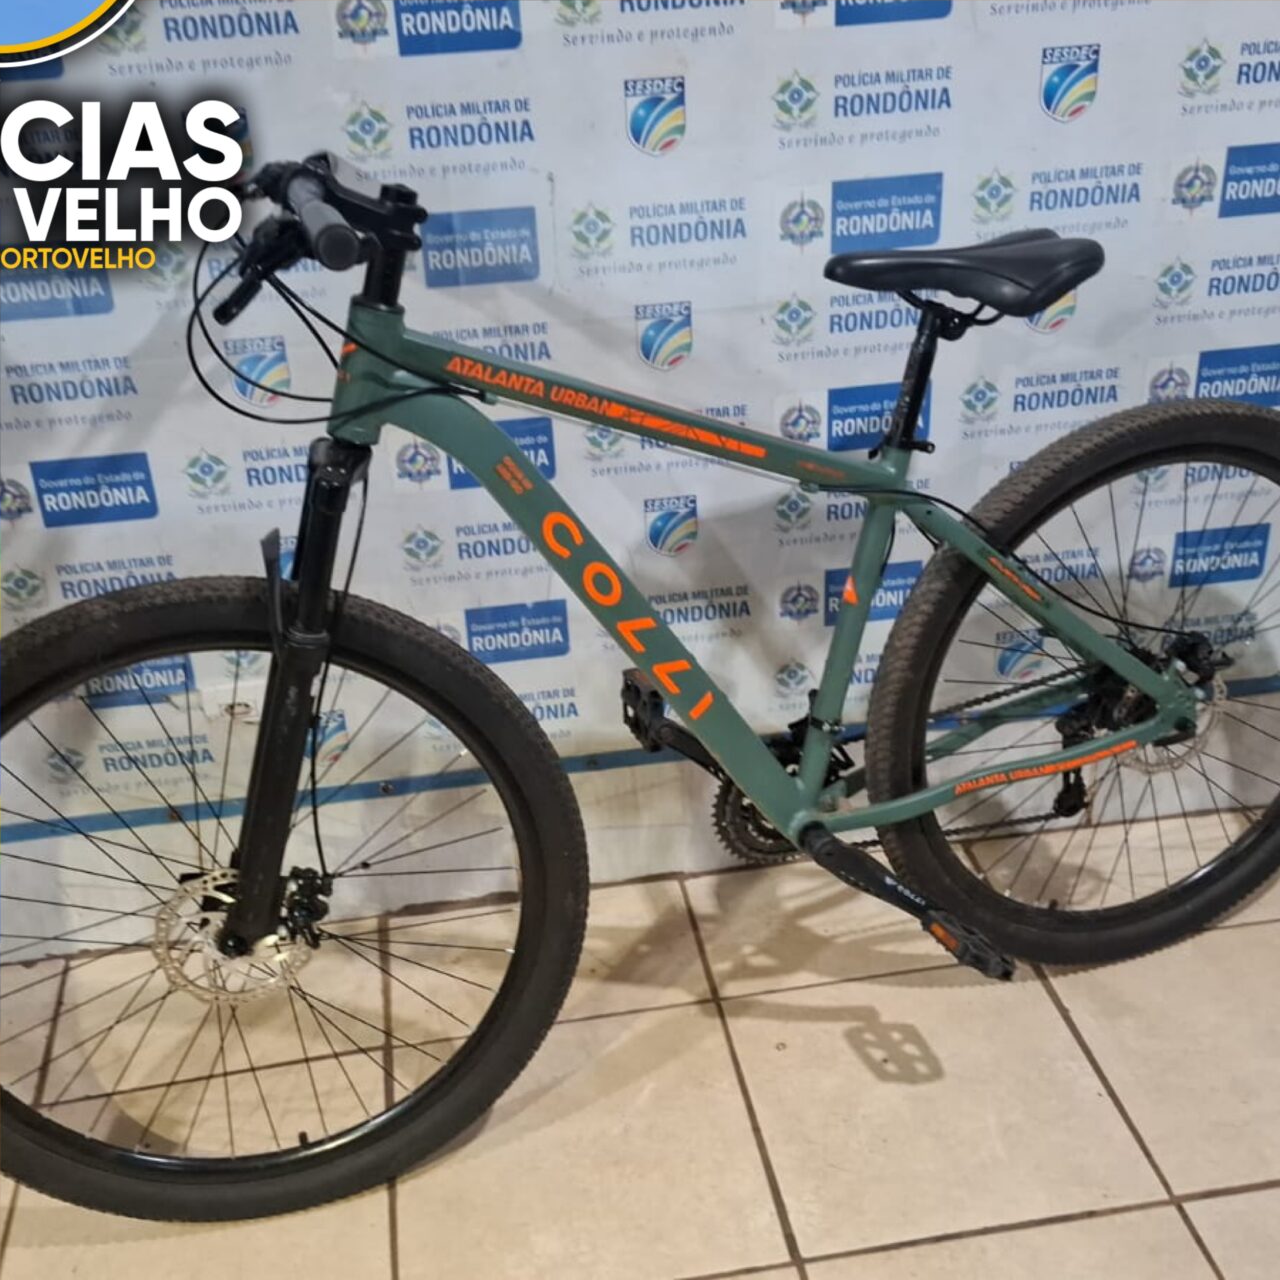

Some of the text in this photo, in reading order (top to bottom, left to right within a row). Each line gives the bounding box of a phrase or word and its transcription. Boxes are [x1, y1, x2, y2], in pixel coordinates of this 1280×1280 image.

[162, 6, 299, 42] RONDÔNIA
[401, 4, 513, 36] RONDÔNIA
[1043, 45, 1099, 63] SESDEC
[625, 78, 684, 96] SESDEC
[834, 66, 952, 88] POLÍCIA MILITAR DE
[406, 98, 531, 119] POLÍCIA MILITAR DE
[834, 85, 952, 118] RONDÔNIA
[409, 117, 535, 150] RONDÔNIA
[1031, 163, 1143, 185] POLÍCIA MILITAR DE
[1029, 181, 1140, 212] RONDÔNIA
[629, 198, 745, 219] POLÍCIA MILITAR DE
[630, 216, 747, 247] RONDÔNIA
[836, 208, 934, 238] RONDÔNIA
[428, 242, 532, 270] RONDÔNIA
[1211, 253, 1280, 271] POLÍCIA MILI
[1207, 267, 1280, 297] RONDÔ
[636, 302, 691, 319] SESDEC
[829, 293, 874, 308] POLÍCIA
[483, 323, 529, 338] MILITAR
[532, 322, 548, 335] DE
[829, 304, 919, 334] RONDÔN
[6, 356, 131, 378] POLÍCIA MILITAR DE
[446, 356, 546, 398] ATALANTA
[1015, 367, 1119, 388] POLÍCIA MILITAR DE
[10, 375, 138, 405] RONDÔNIA
[1013, 384, 1118, 412] RONDÔNIA
[732, 404, 748, 417] DE
[832, 411, 924, 437] RONDÔ
[242, 447, 289, 462] POLÍCIA
[246, 466, 307, 488] ROND
[42, 485, 150, 512] RONDÔNIA
[645, 496, 696, 511] SESDEC
[456, 523, 499, 537] POLÍCIA
[458, 536, 531, 560] RONDÔ
[106, 557, 154, 570] MILITAR
[156, 554, 173, 566] DE
[692, 587, 734, 600] MILITAR
[736, 585, 748, 596] DE
[542, 511, 714, 720] COLLI
[662, 599, 751, 625] ONDÔNIA
[472, 626, 563, 652] RONDÔNIA
[563, 687, 576, 698] DE
